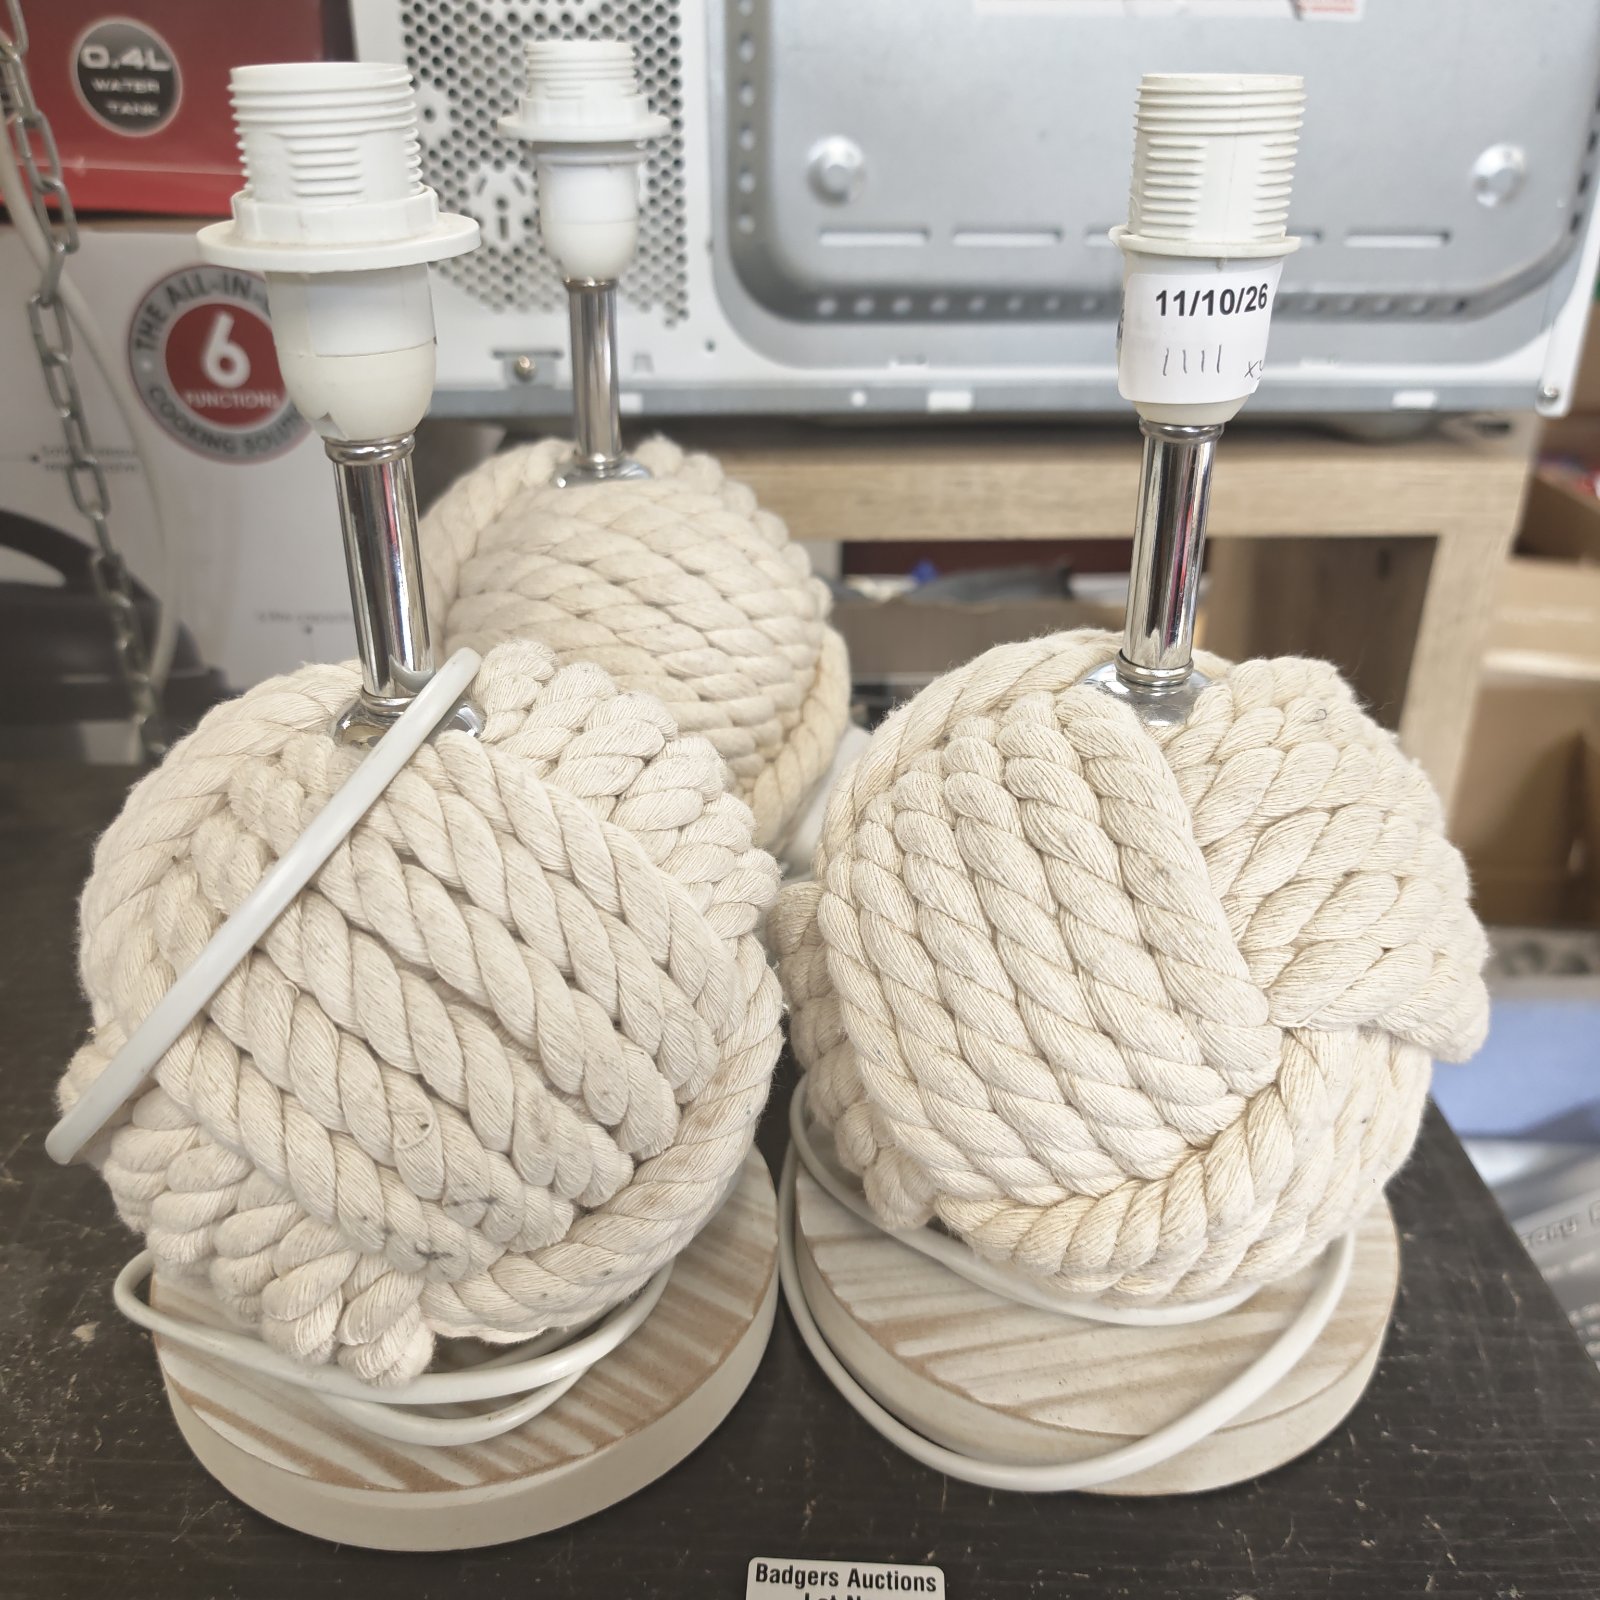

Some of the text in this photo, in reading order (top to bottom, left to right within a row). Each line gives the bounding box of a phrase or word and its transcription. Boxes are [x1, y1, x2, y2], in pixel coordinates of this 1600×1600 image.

[81, 45, 172, 72] 0.4L
[91, 78, 160, 94] WATER
[1155, 283, 1268, 317] 11/10/26
[134, 303, 169, 350] THE
[203, 310, 251, 389] 6
[150, 386, 236, 453] COOKING
[755, 1562, 937, 1592] Badgers Auctions
